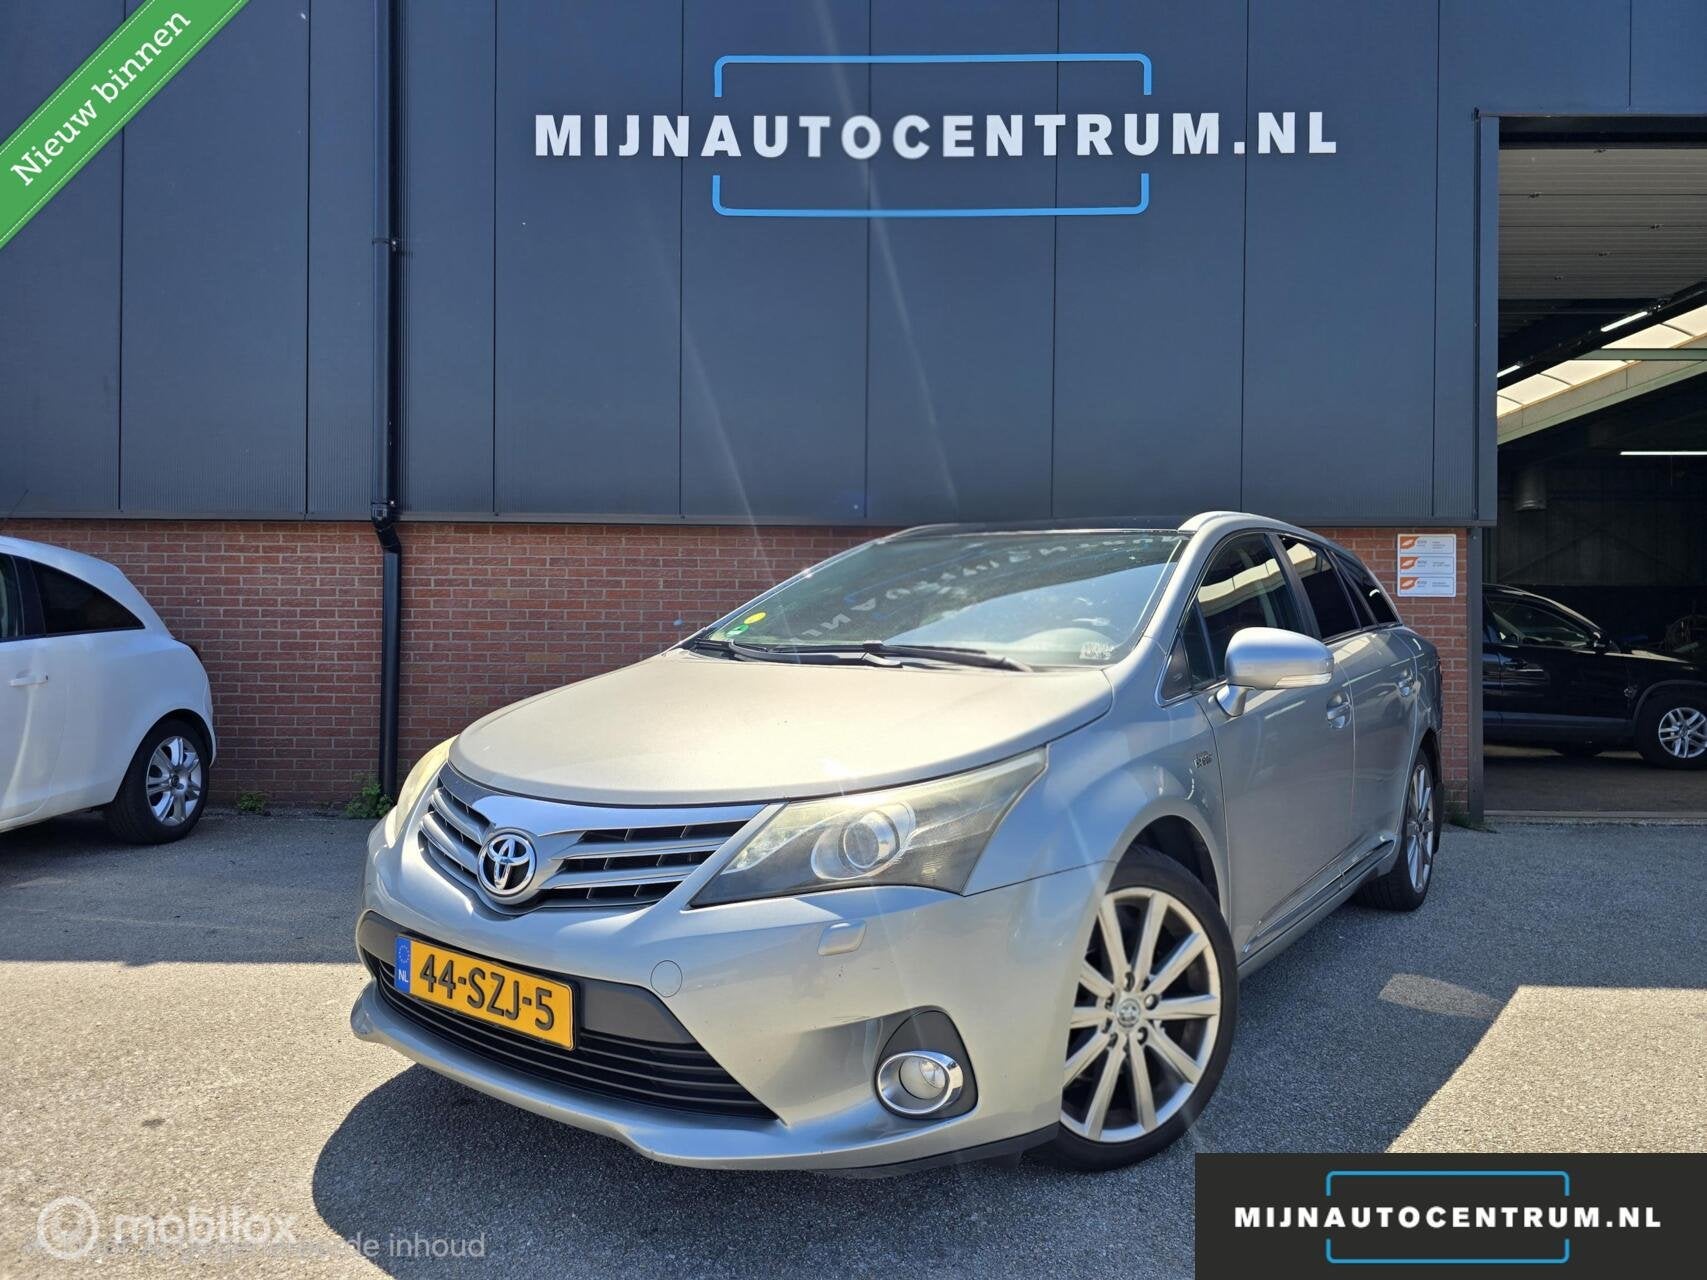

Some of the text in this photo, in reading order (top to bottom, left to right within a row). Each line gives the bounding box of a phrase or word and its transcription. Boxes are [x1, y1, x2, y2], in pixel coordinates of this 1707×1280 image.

[534, 111, 1337, 159] MIJNAUTOCENTRUM.NL
[398, 968, 409, 983] NL
[419, 953, 555, 1031] 44-SZJ-5
